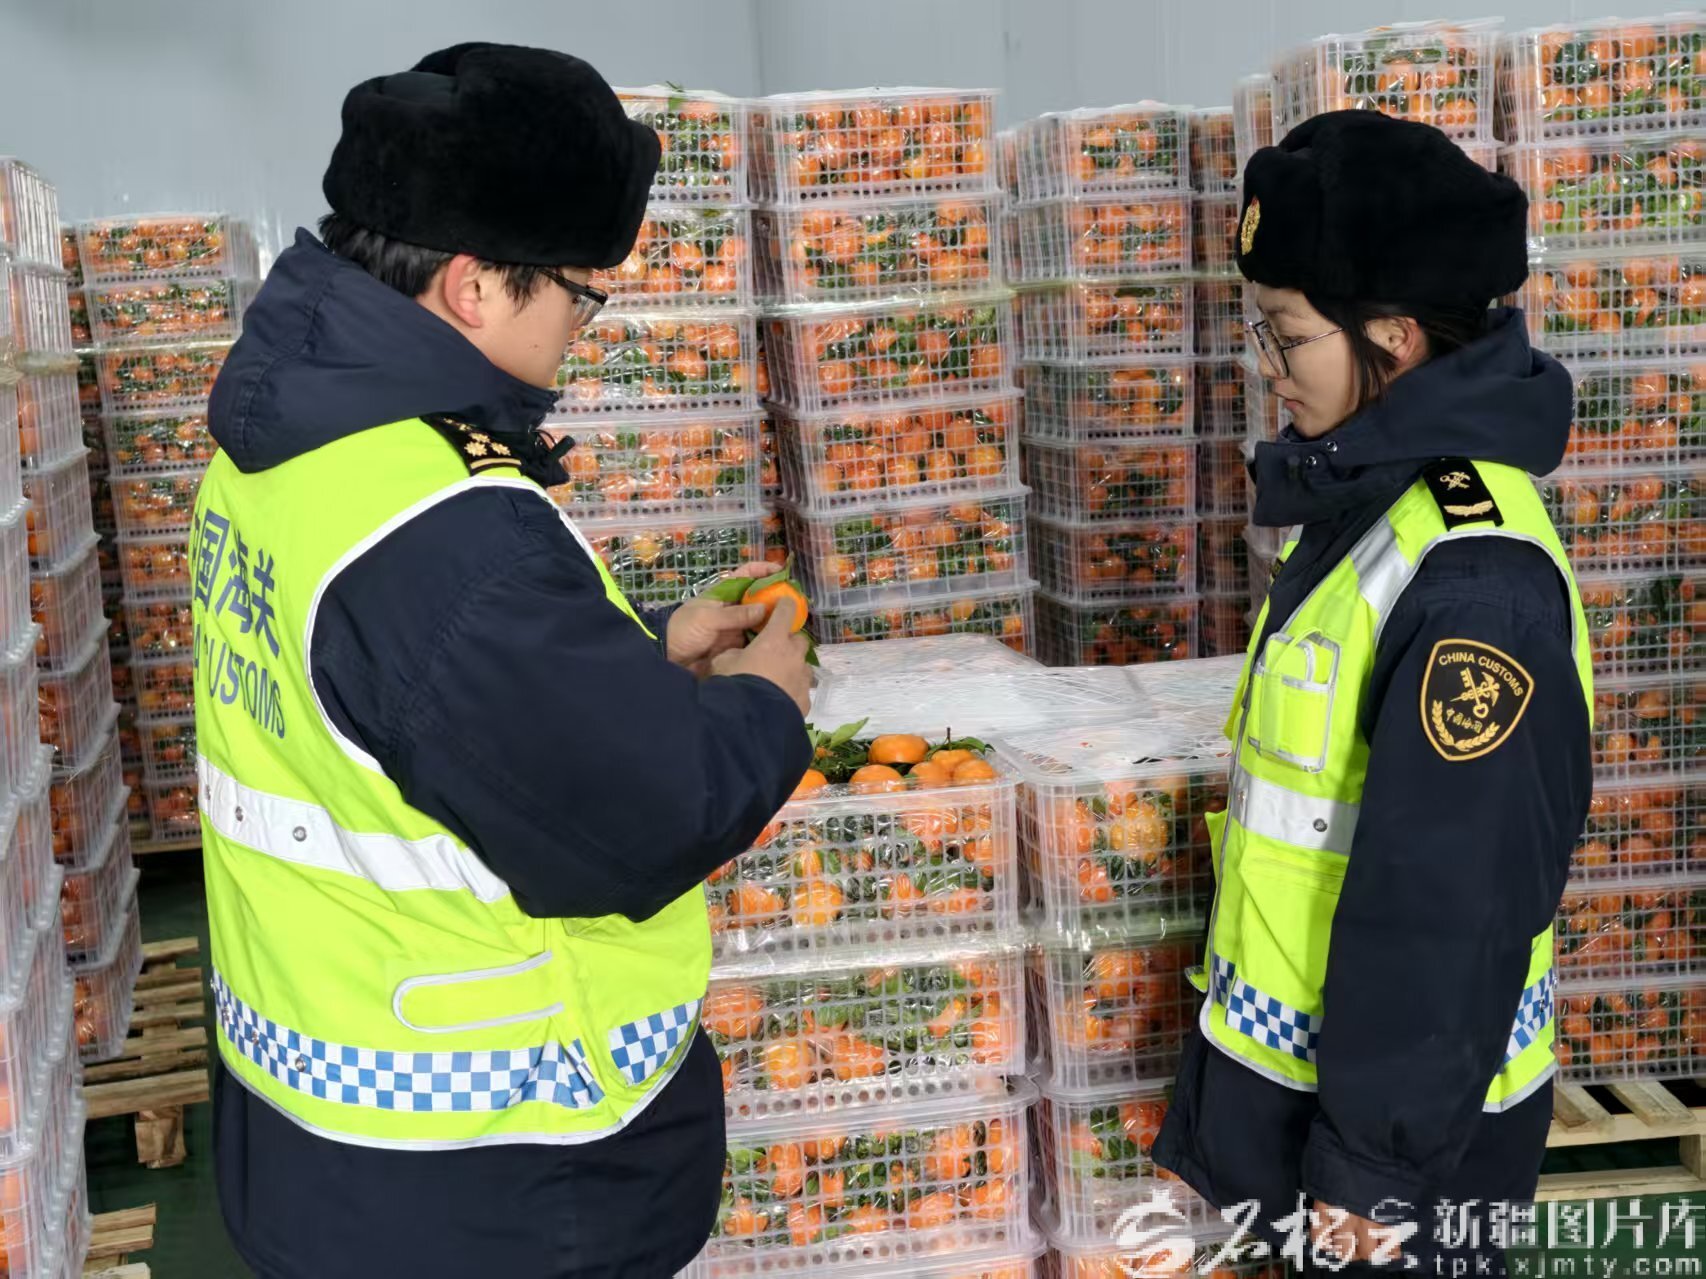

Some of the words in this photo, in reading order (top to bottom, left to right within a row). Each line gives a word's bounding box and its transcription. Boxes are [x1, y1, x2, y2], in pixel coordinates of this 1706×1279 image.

[204, 633, 285, 739] USTOMS
[1438, 651, 1476, 666] CHINA
[1478, 655, 1524, 697] CUSTOMS
